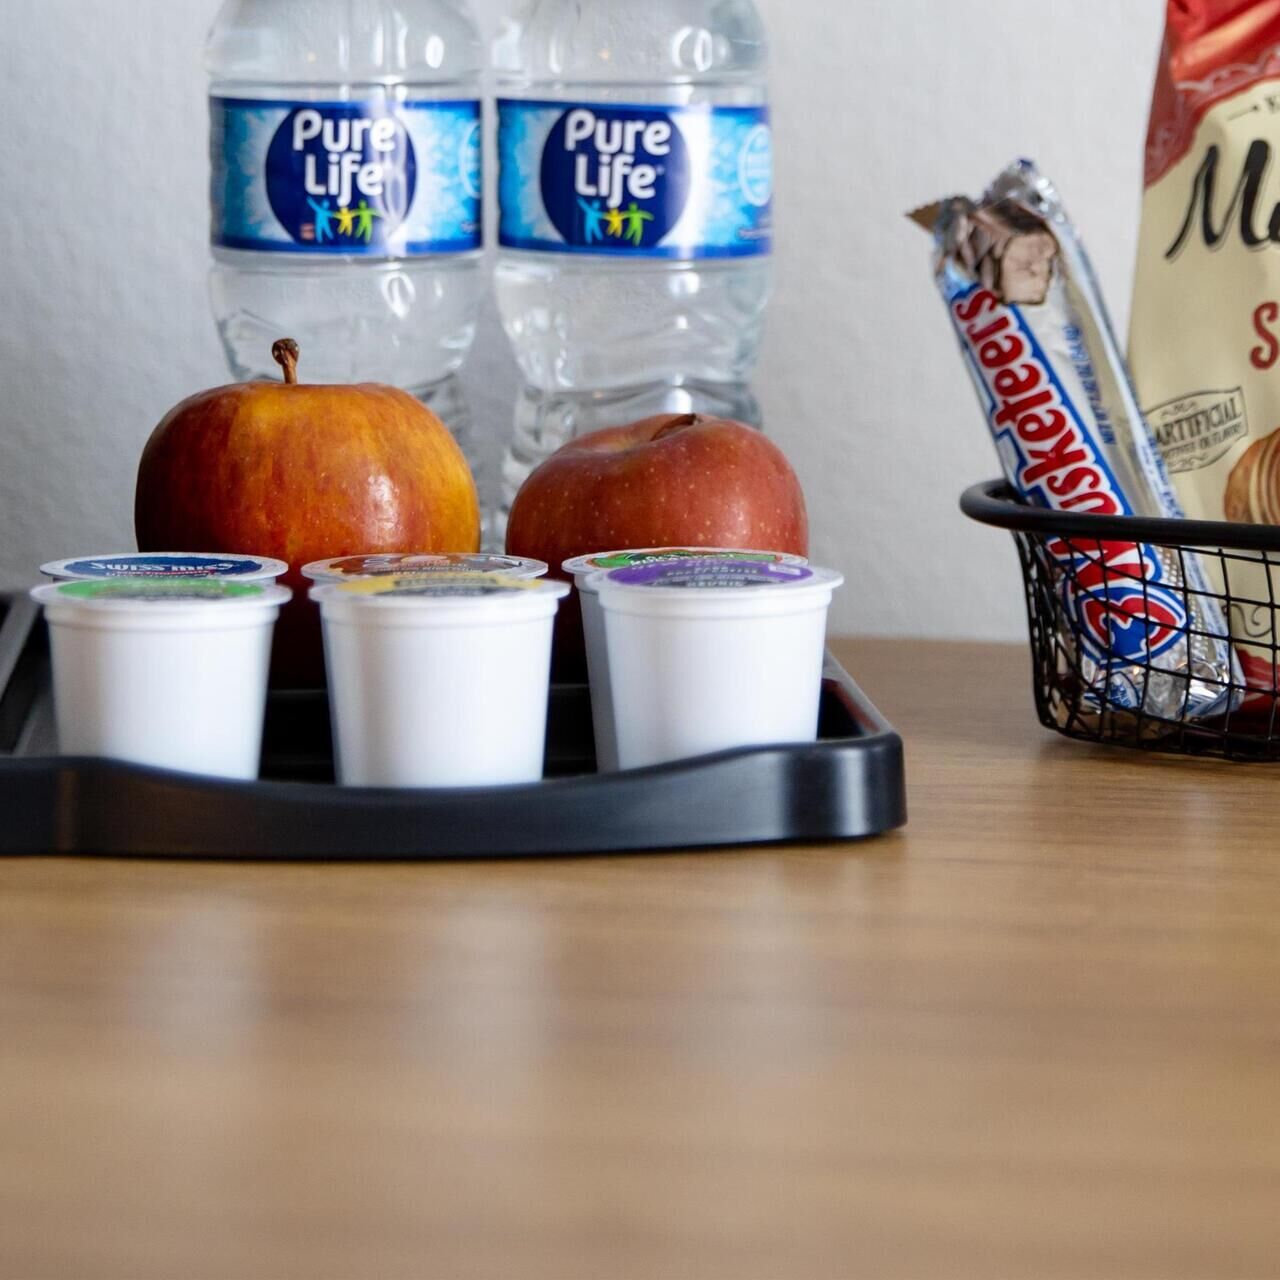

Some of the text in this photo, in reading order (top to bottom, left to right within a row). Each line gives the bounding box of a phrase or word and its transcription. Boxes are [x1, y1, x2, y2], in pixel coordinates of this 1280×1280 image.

[293, 108, 396, 153] Pure
[565, 108, 672, 155] Pure
[305, 153, 384, 207] Life
[575, 153, 657, 208] Life
[954, 290, 1179, 651] 3 Musketeers
